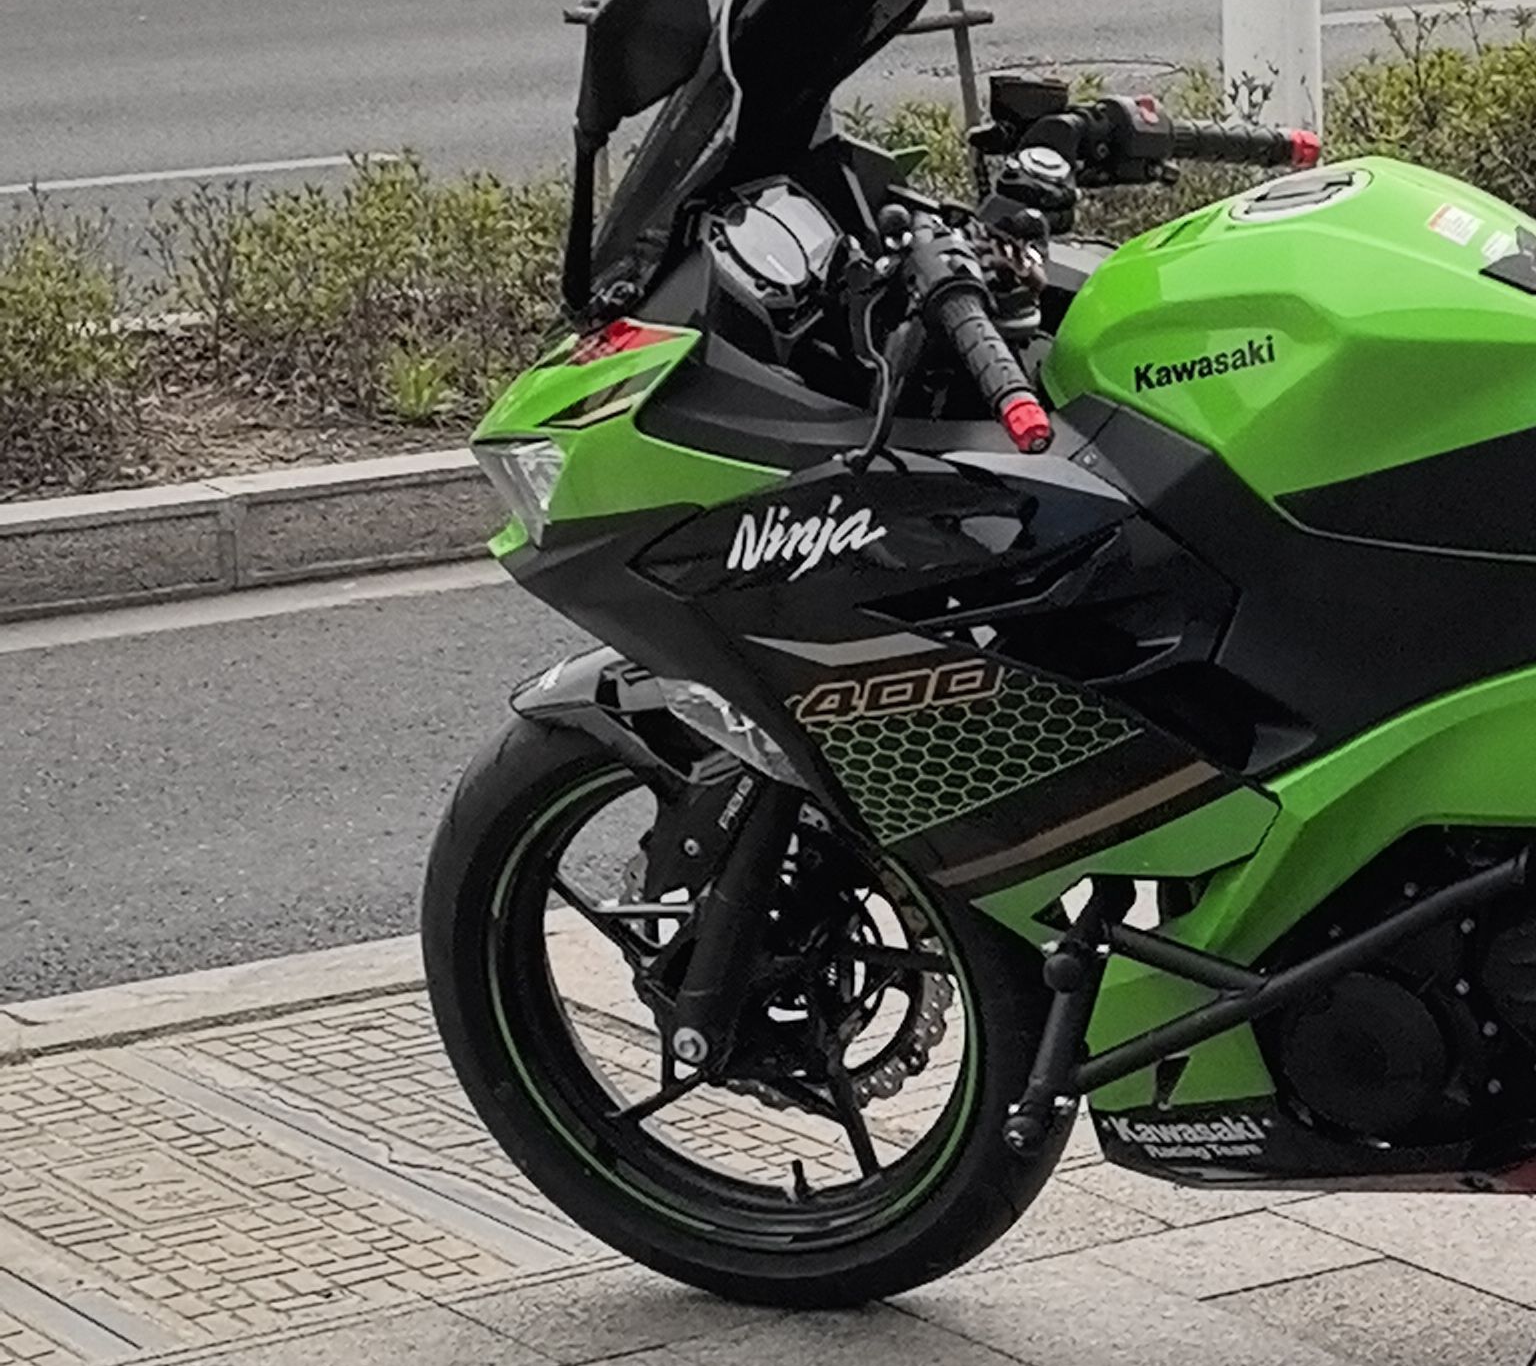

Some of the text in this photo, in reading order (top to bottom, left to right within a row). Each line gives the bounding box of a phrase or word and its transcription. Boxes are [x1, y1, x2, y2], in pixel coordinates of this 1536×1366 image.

[1133, 335, 1276, 393] Kawasaki
[726, 494, 887, 582] Ninja
[796, 658, 1002, 723] 400
[1108, 1115, 1266, 1143] Kawasaki
